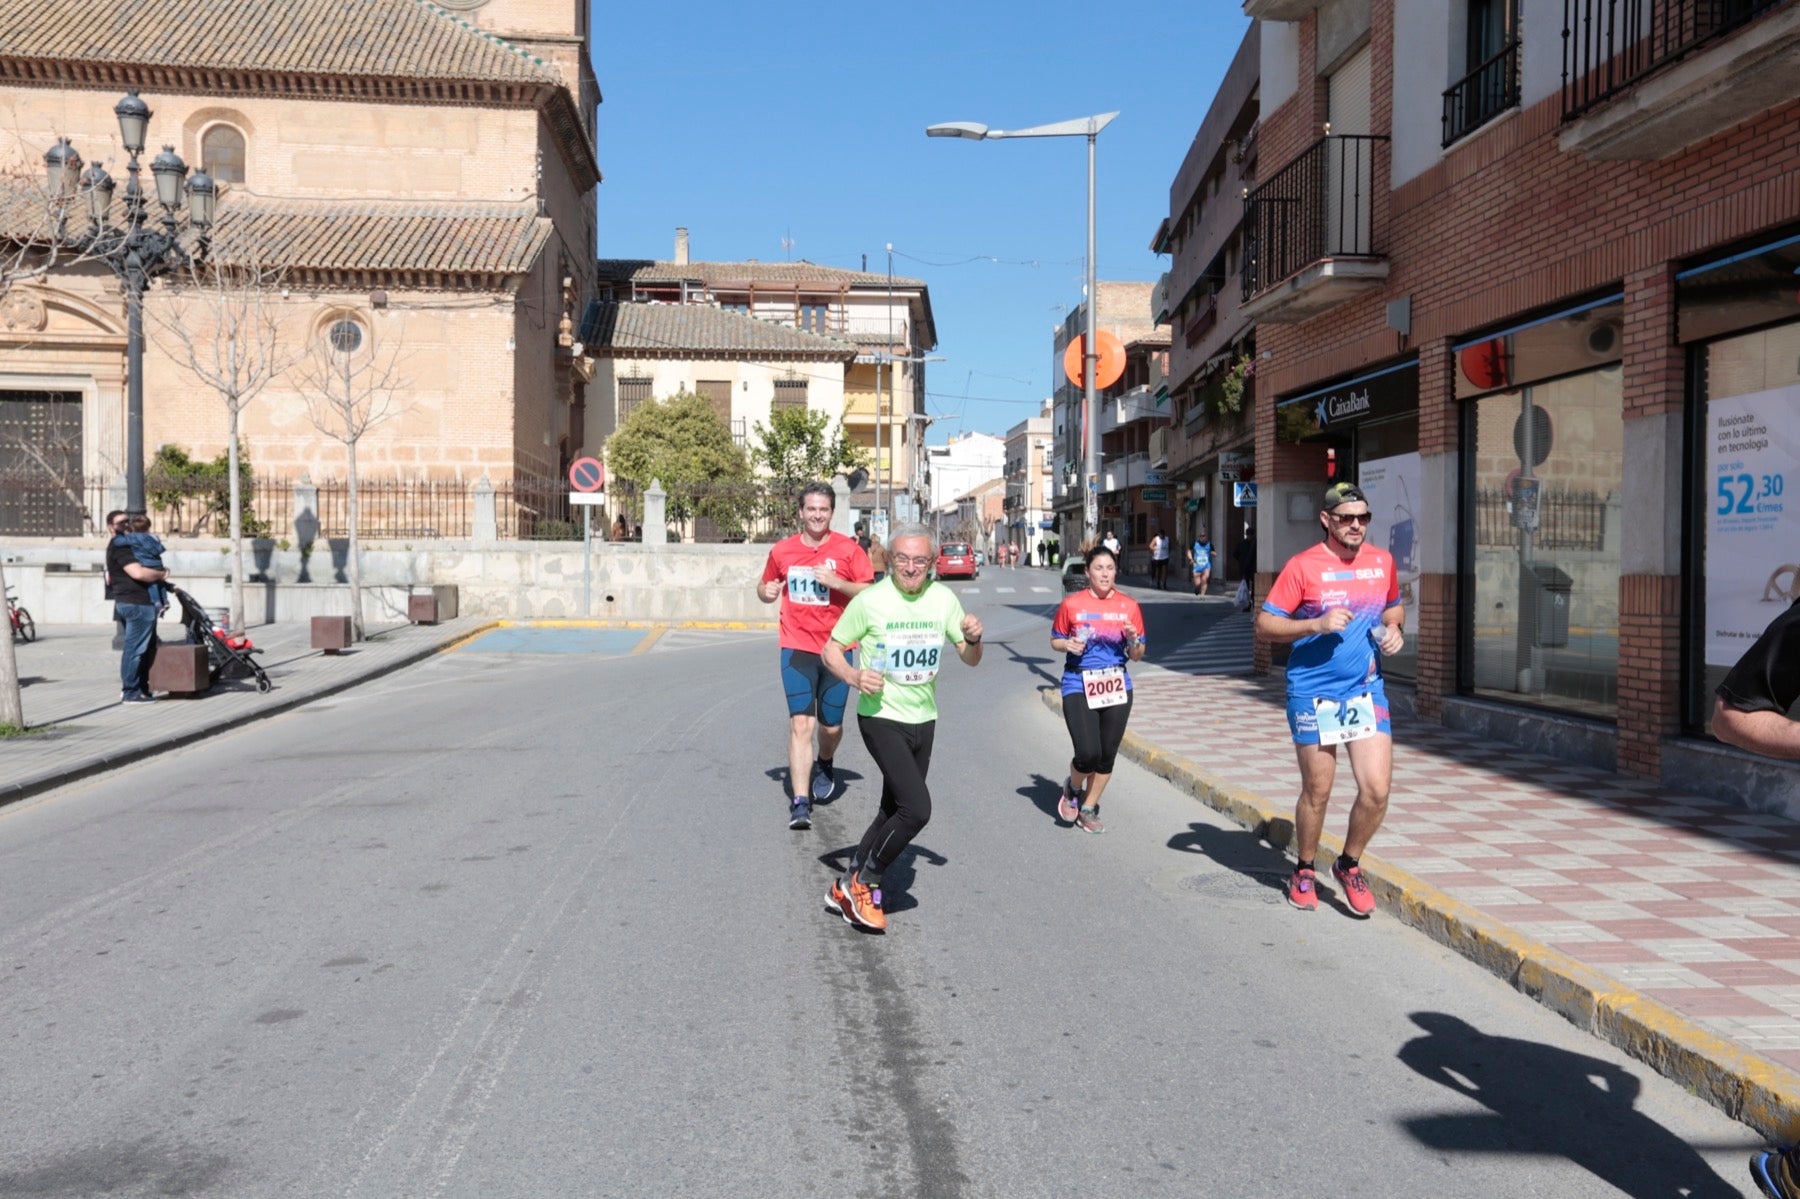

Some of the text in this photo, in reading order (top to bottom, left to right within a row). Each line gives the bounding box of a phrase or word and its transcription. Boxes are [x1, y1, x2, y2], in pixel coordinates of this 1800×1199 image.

[1329, 388, 1370, 417] CaixaBank
[1718, 414, 1755, 428] Ilusiónate
[1718, 430, 1731, 441] con
[1733, 428, 1740, 439] lo
[1718, 444, 1727, 454] en
[1717, 460, 1744, 473] por solo
[1355, 568, 1384, 579] SEUR
[886, 621, 934, 630] MARCELINO
[891, 648, 938, 668] 1048
[1087, 678, 1123, 696] 2002
